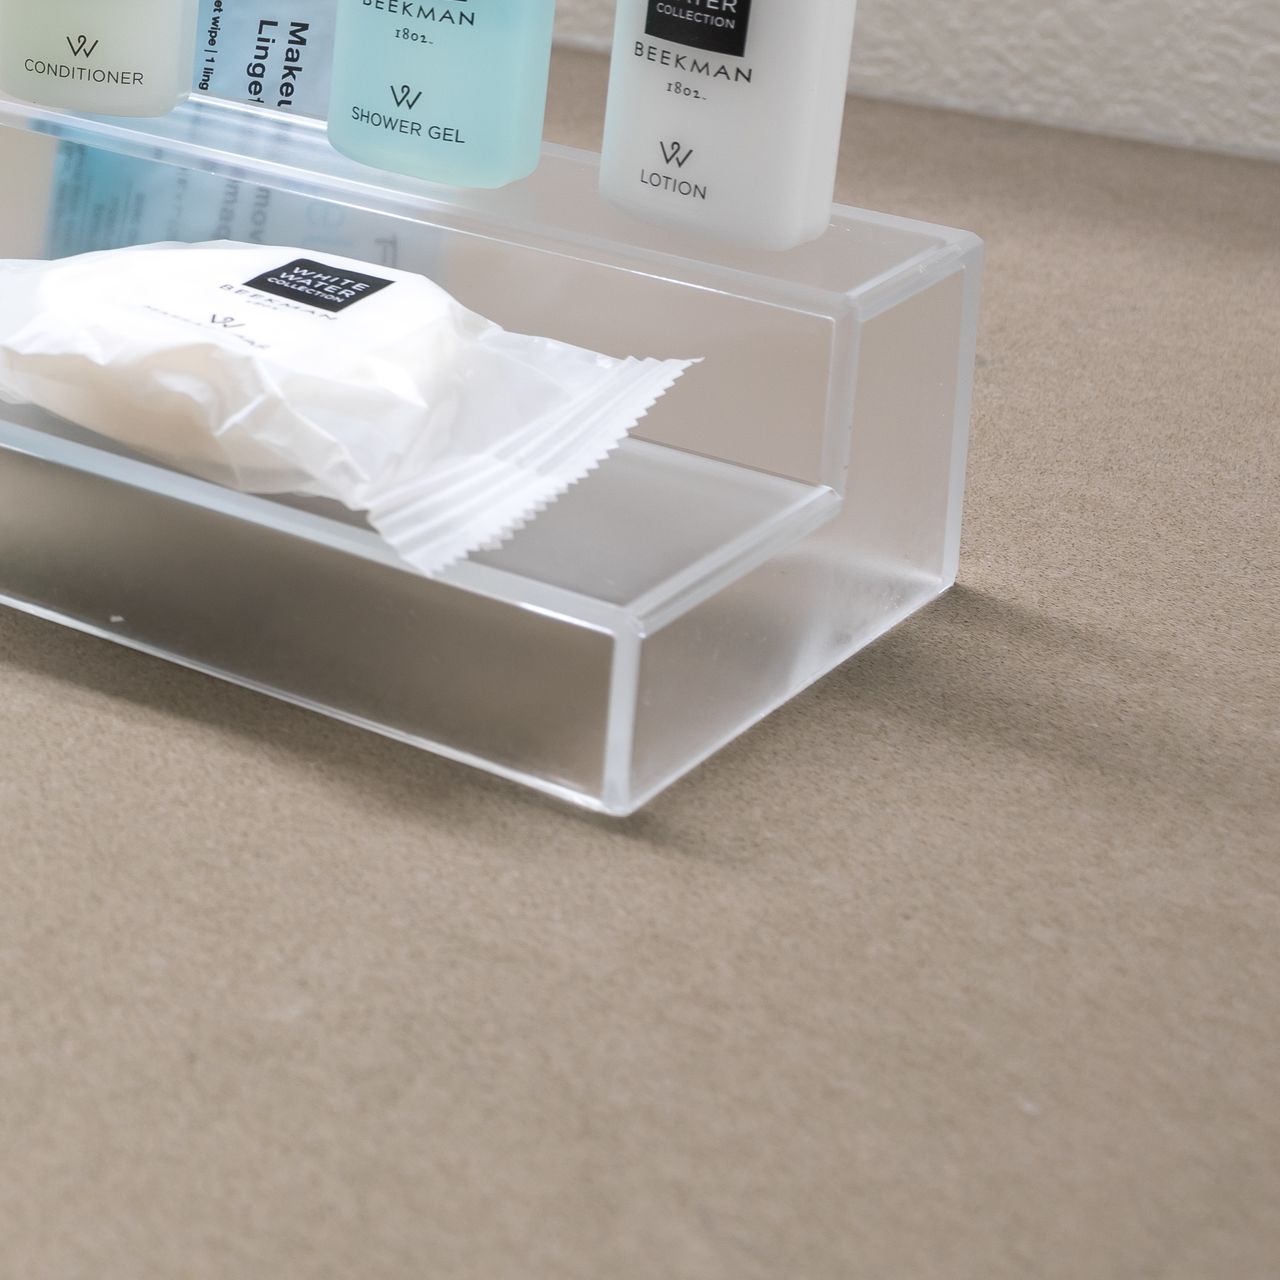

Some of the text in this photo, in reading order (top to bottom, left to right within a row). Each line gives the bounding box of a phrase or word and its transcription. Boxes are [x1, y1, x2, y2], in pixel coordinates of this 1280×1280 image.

[656, 2, 736, 30] COLLECTION
[207, 16, 221, 47] wipe
[24, 58, 144, 85] CONDITIONER
[634, 41, 753, 83] BEEKMAN
[351, 106, 465, 144] SHOWER GEL
[640, 169, 707, 200] LOTION
[267, 277, 345, 303] COLLECTION
[280, 272, 356, 299] WATER
[293, 266, 370, 292] WHITE
